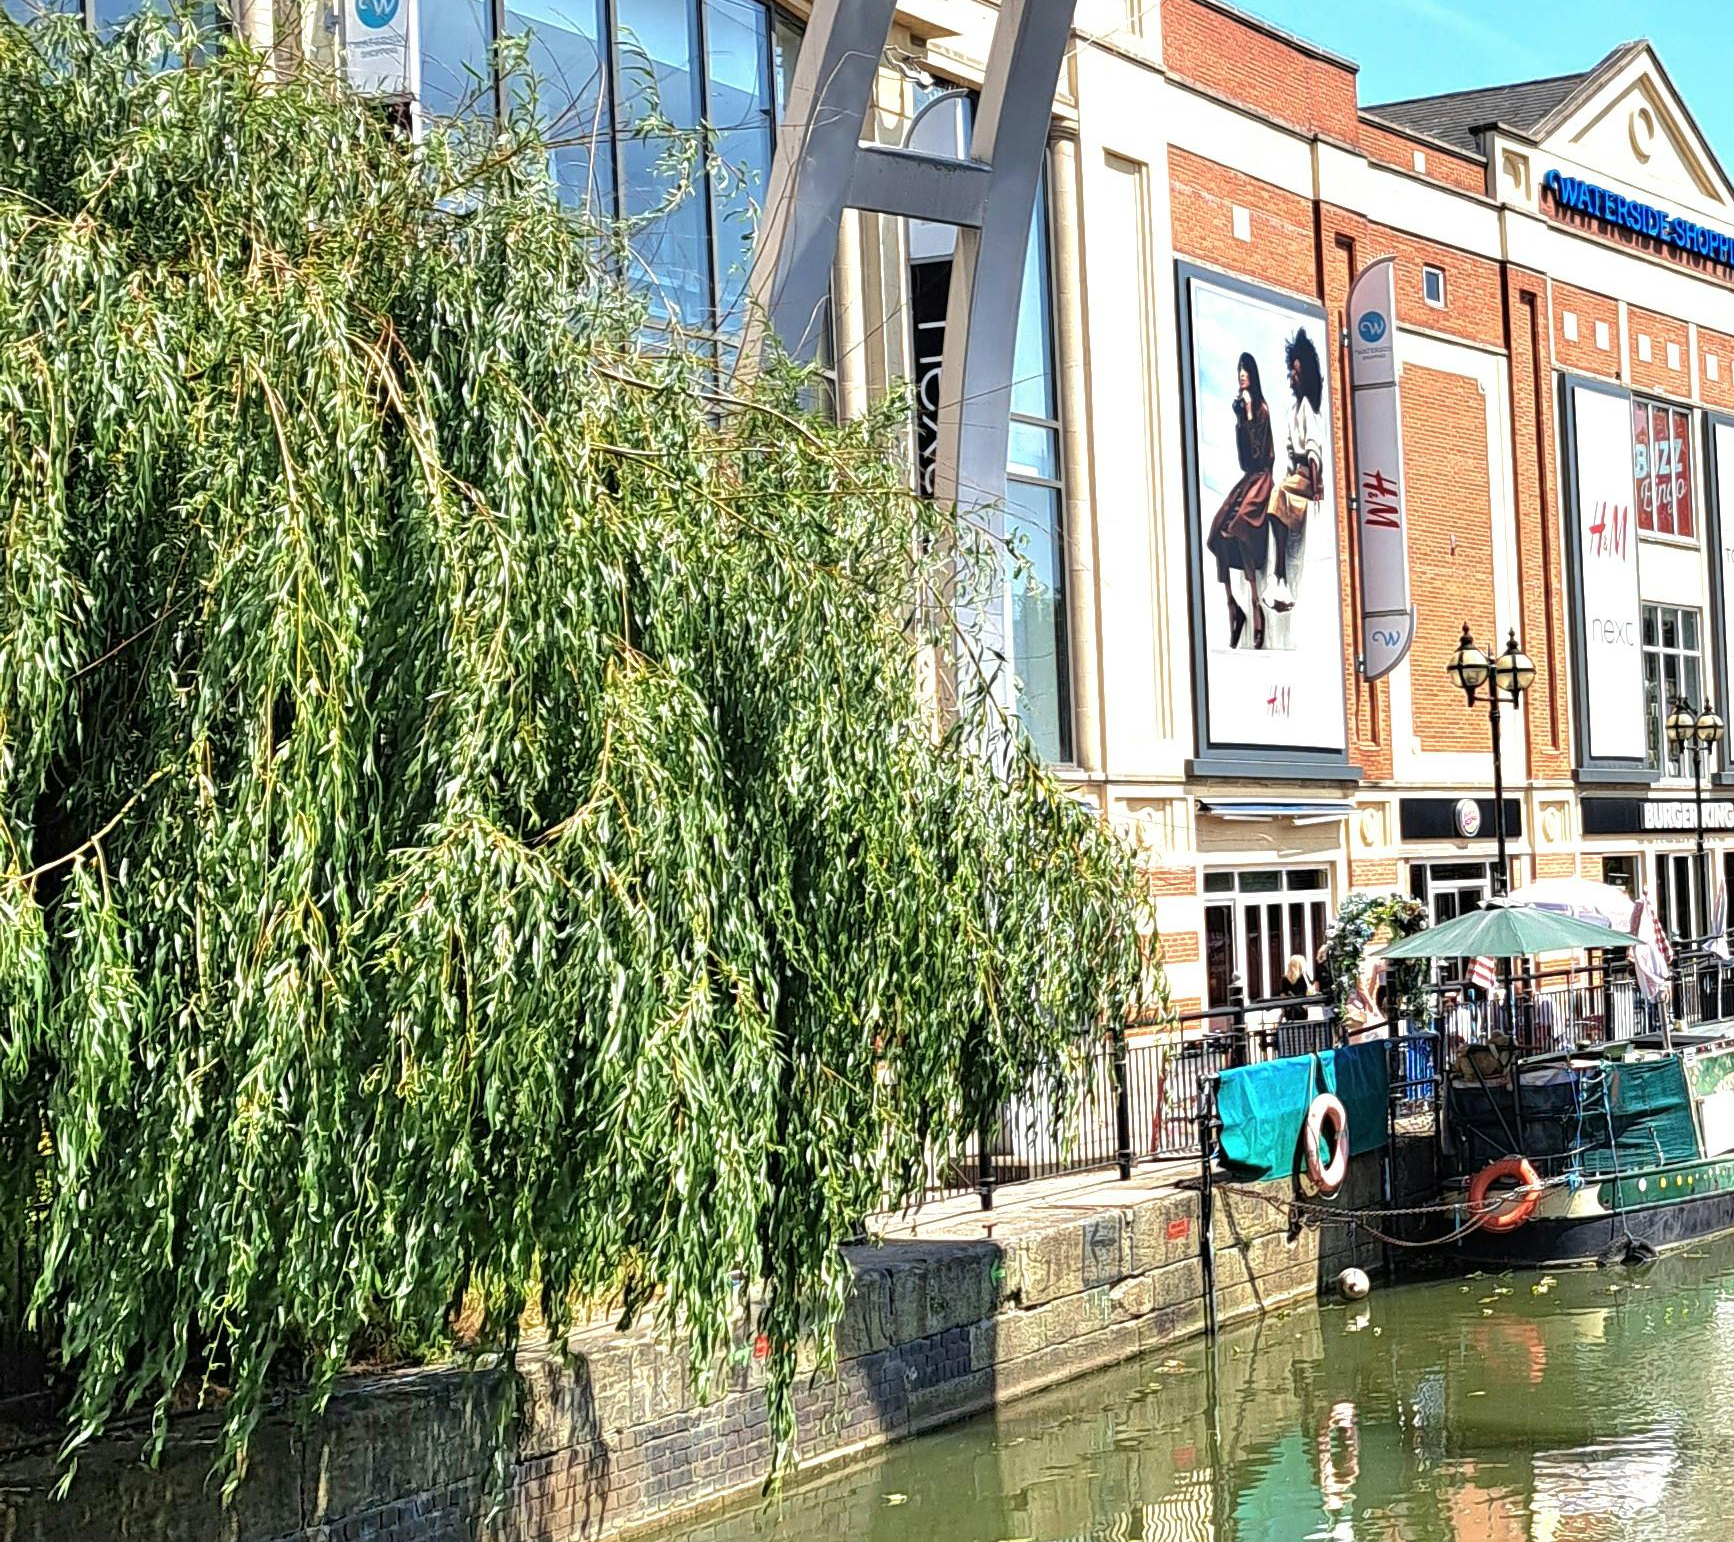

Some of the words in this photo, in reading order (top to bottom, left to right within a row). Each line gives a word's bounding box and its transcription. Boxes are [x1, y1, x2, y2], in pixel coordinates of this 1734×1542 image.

[1543, 169, 1671, 243] WATERSIDE
[1362, 469, 1401, 529] H&M
[1588, 500, 1628, 563] H&M
[1592, 617, 1635, 647] next
[1643, 801, 1698, 829] BURGER
